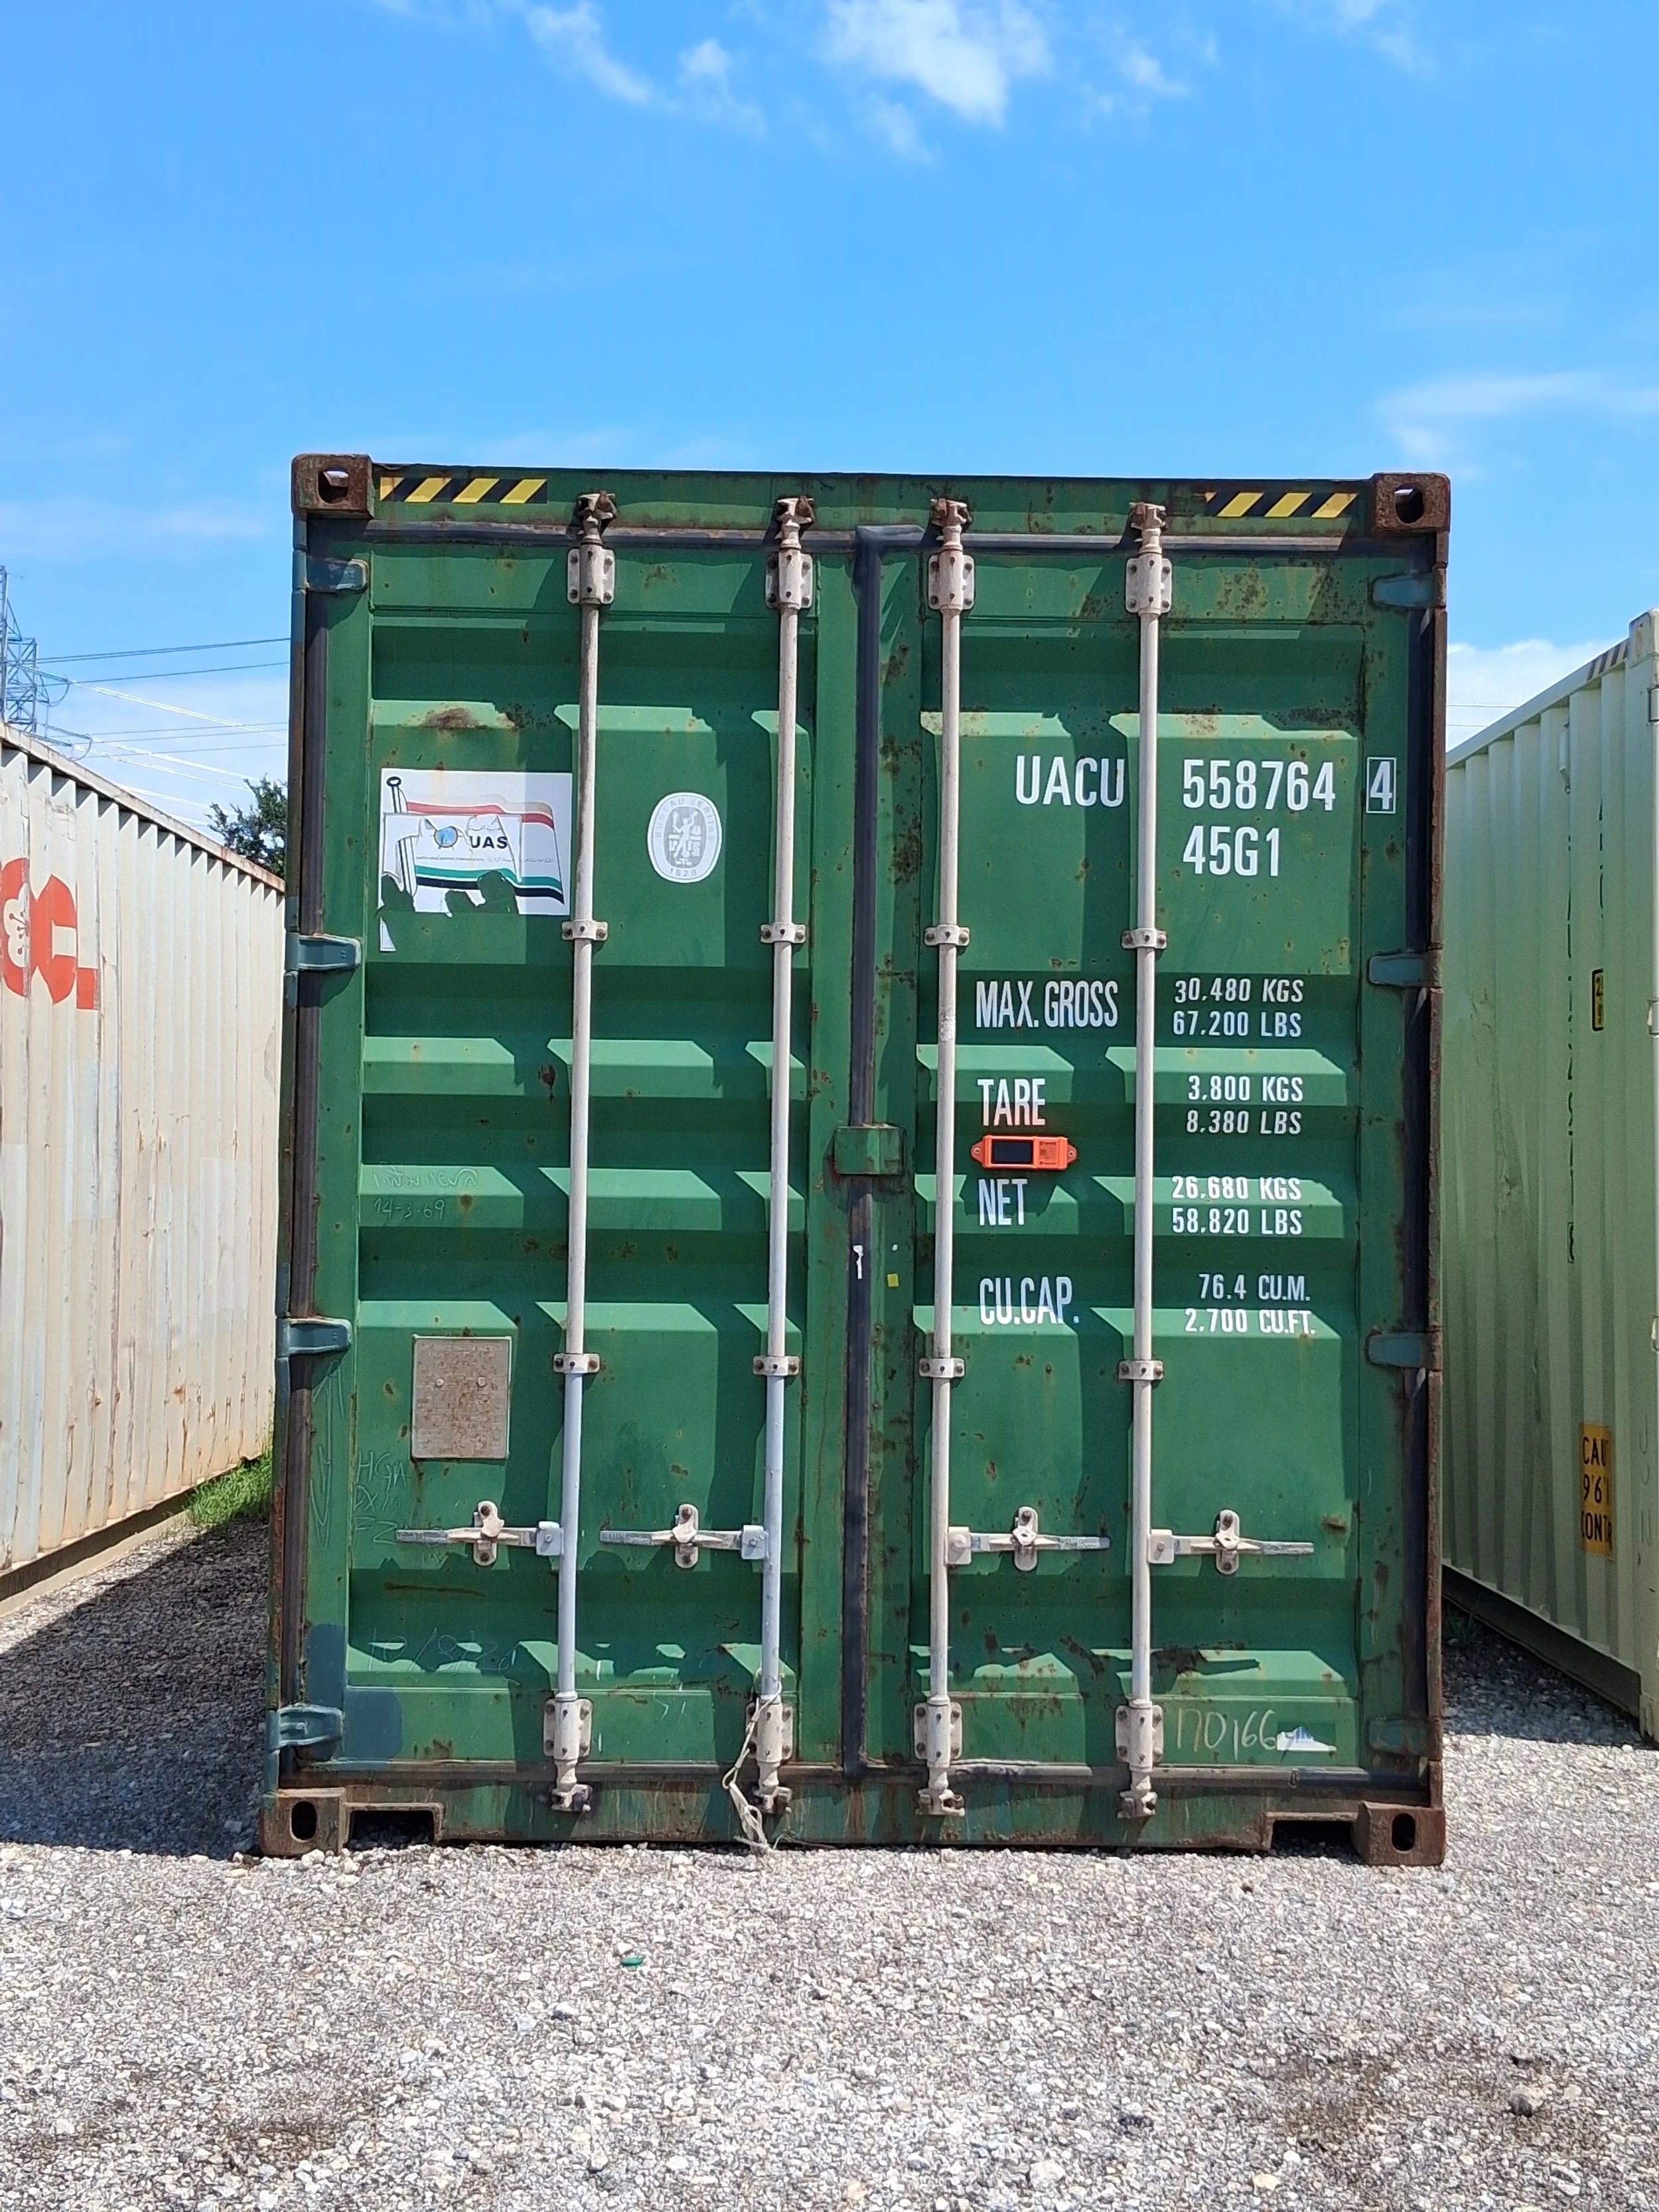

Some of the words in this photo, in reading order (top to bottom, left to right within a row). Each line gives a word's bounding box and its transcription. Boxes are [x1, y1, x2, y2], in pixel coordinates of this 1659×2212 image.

[1015, 755, 1125, 808] UACU
[1183, 759, 1336, 811] 558764
[1369, 760, 1394, 810] 4
[470, 835, 508, 849] UAS
[1182, 824, 1280, 877] 45G1
[975, 980, 1039, 1028] MAX.
[1044, 980, 1119, 1028] GROSS
[1262, 978, 1305, 1003] KGS
[1260, 1011, 1302, 1037] LBS
[977, 1078, 1046, 1126] TARE
[1262, 1076, 1304, 1102] KGS
[1260, 1110, 1302, 1135] LBS
[978, 1178, 1028, 1226] NET
[1259, 1176, 1302, 1201] KGS
[1260, 1209, 1303, 1235] LBS
[979, 1276, 1080, 1325] CU.CAP.
[1198, 1273, 1247, 1300] 76.4
[1258, 1274, 1311, 1301] CU.M.
[1258, 1308, 1316, 1335] CU.FT.
